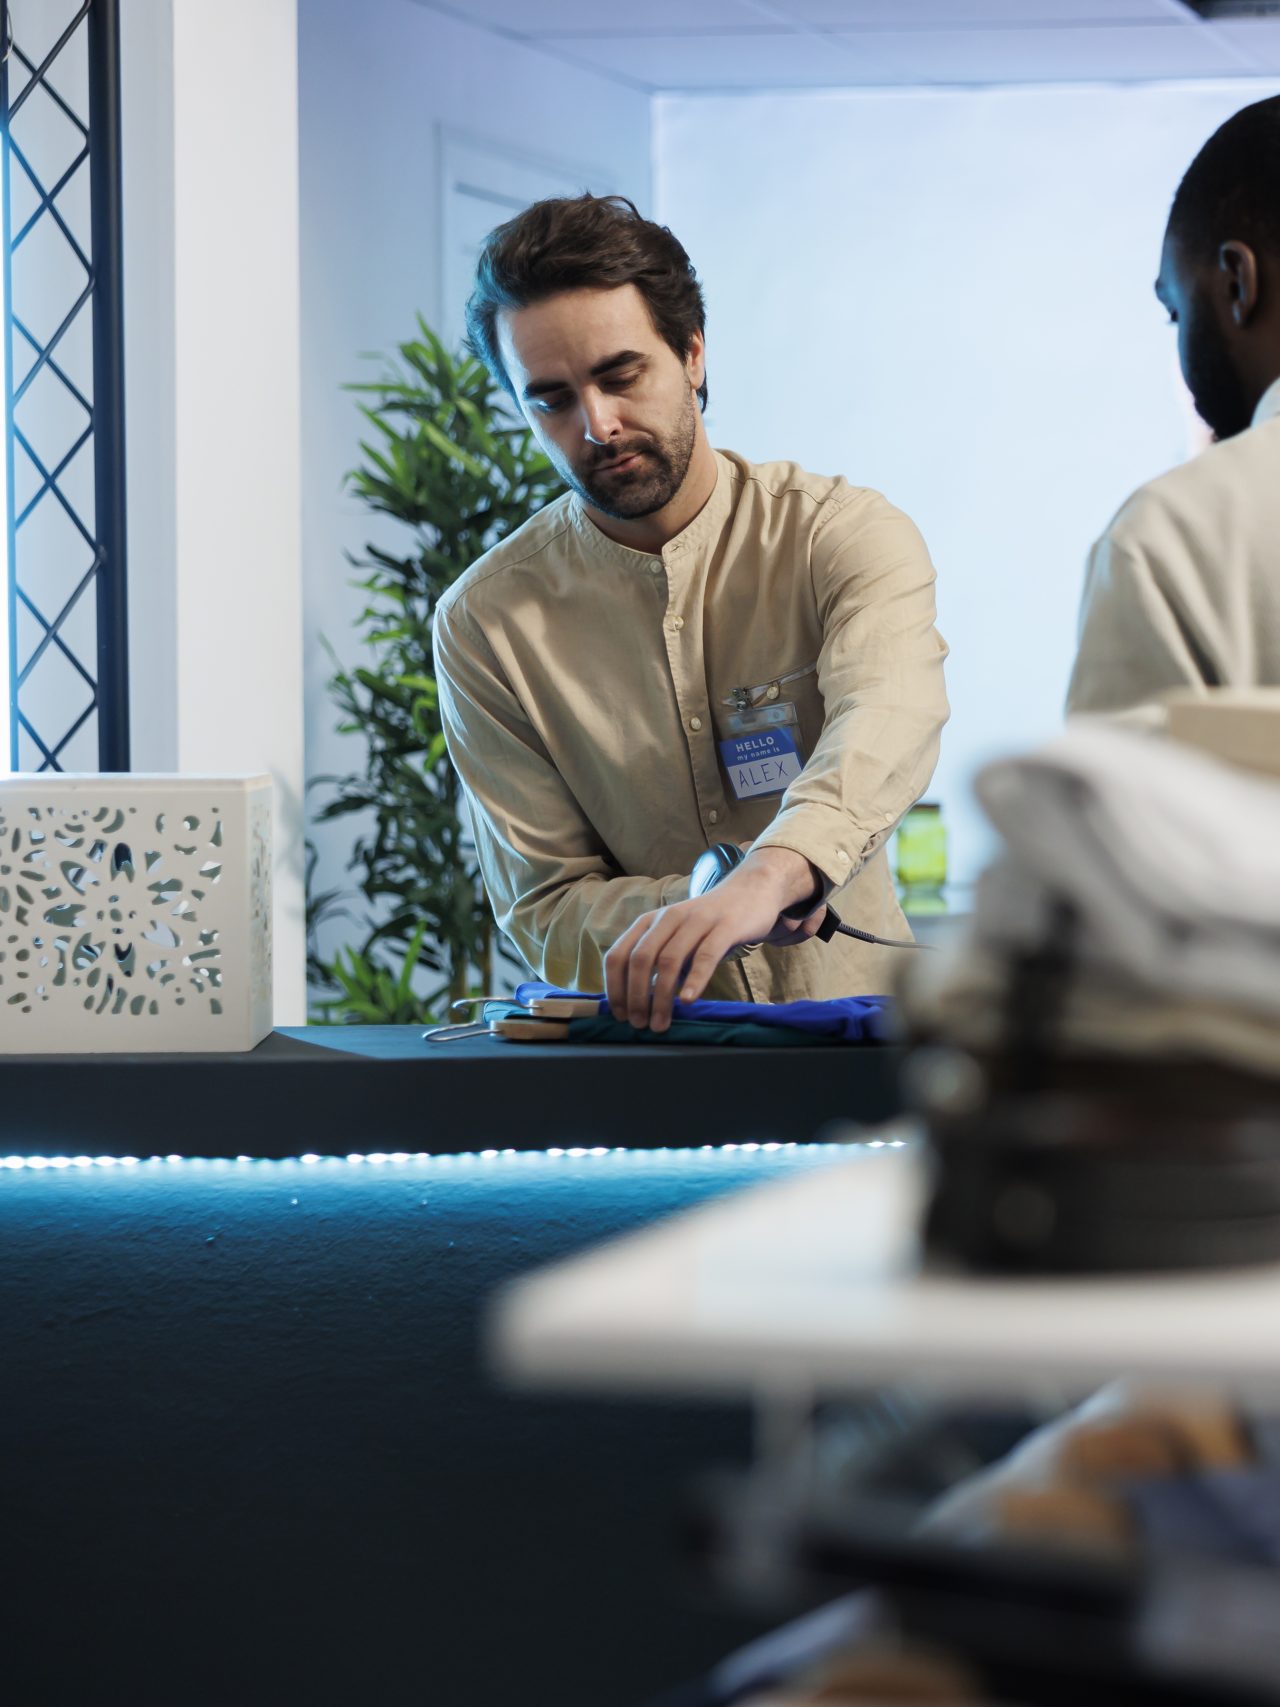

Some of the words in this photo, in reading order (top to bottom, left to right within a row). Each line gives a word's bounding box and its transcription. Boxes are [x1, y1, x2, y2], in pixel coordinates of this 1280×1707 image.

[736, 736, 775, 753] HELLO
[737, 753, 748, 761] my
[751, 749, 771, 758] name
[739, 760, 789, 788] ALEX
